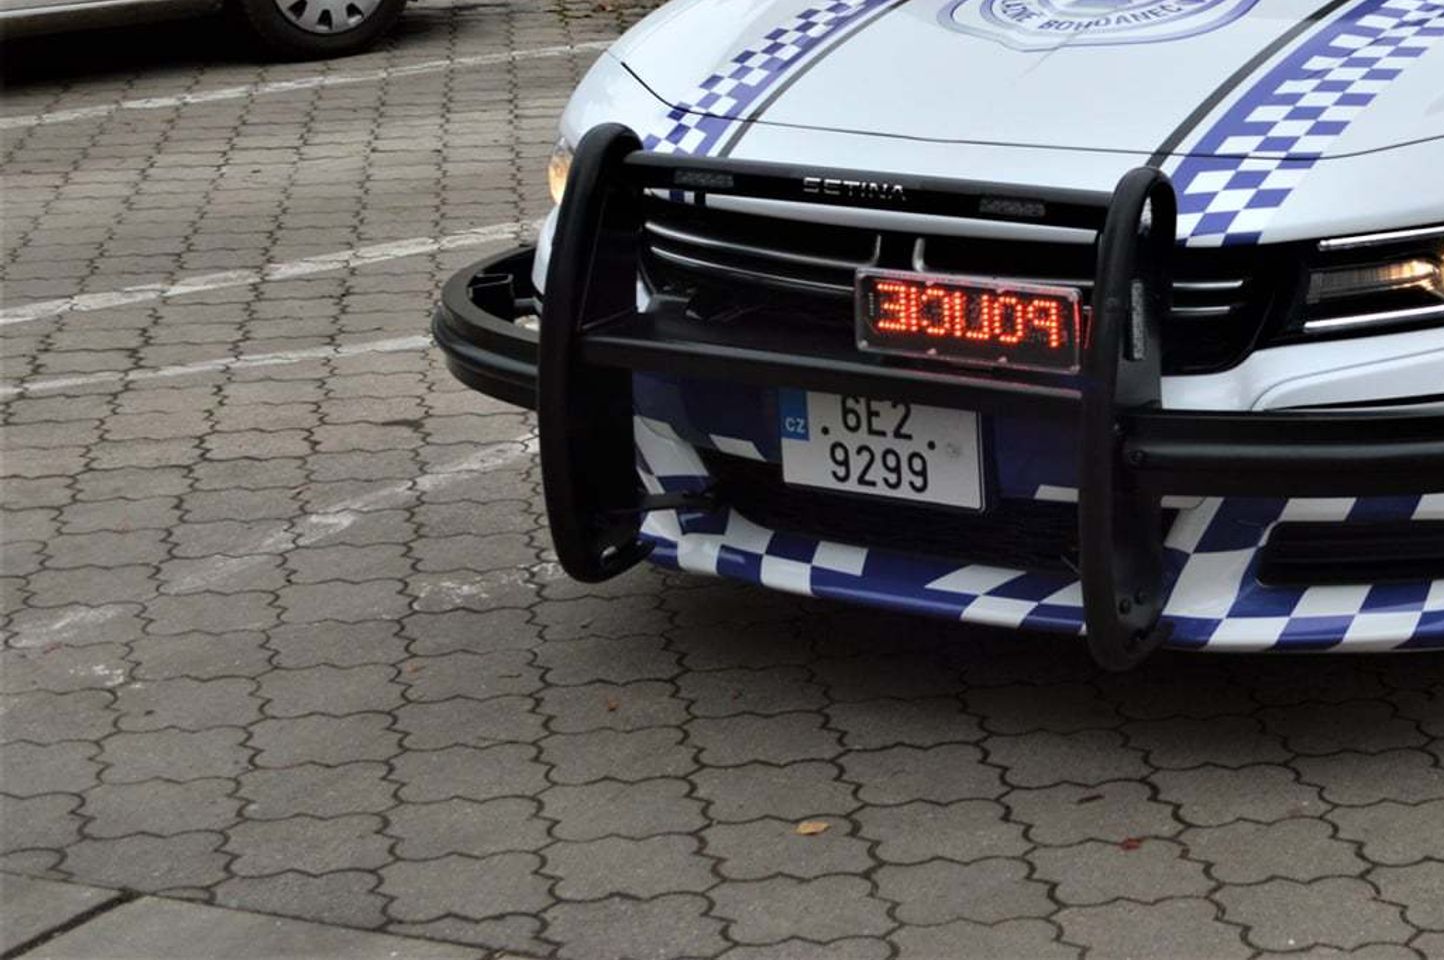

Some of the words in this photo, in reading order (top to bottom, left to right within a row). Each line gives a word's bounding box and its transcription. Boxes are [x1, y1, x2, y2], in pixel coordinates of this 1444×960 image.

[803, 176, 908, 202] SETINA
[784, 416, 807, 434] CZ
[840, 394, 914, 441] 6E2
[829, 441, 929, 494] 9299
